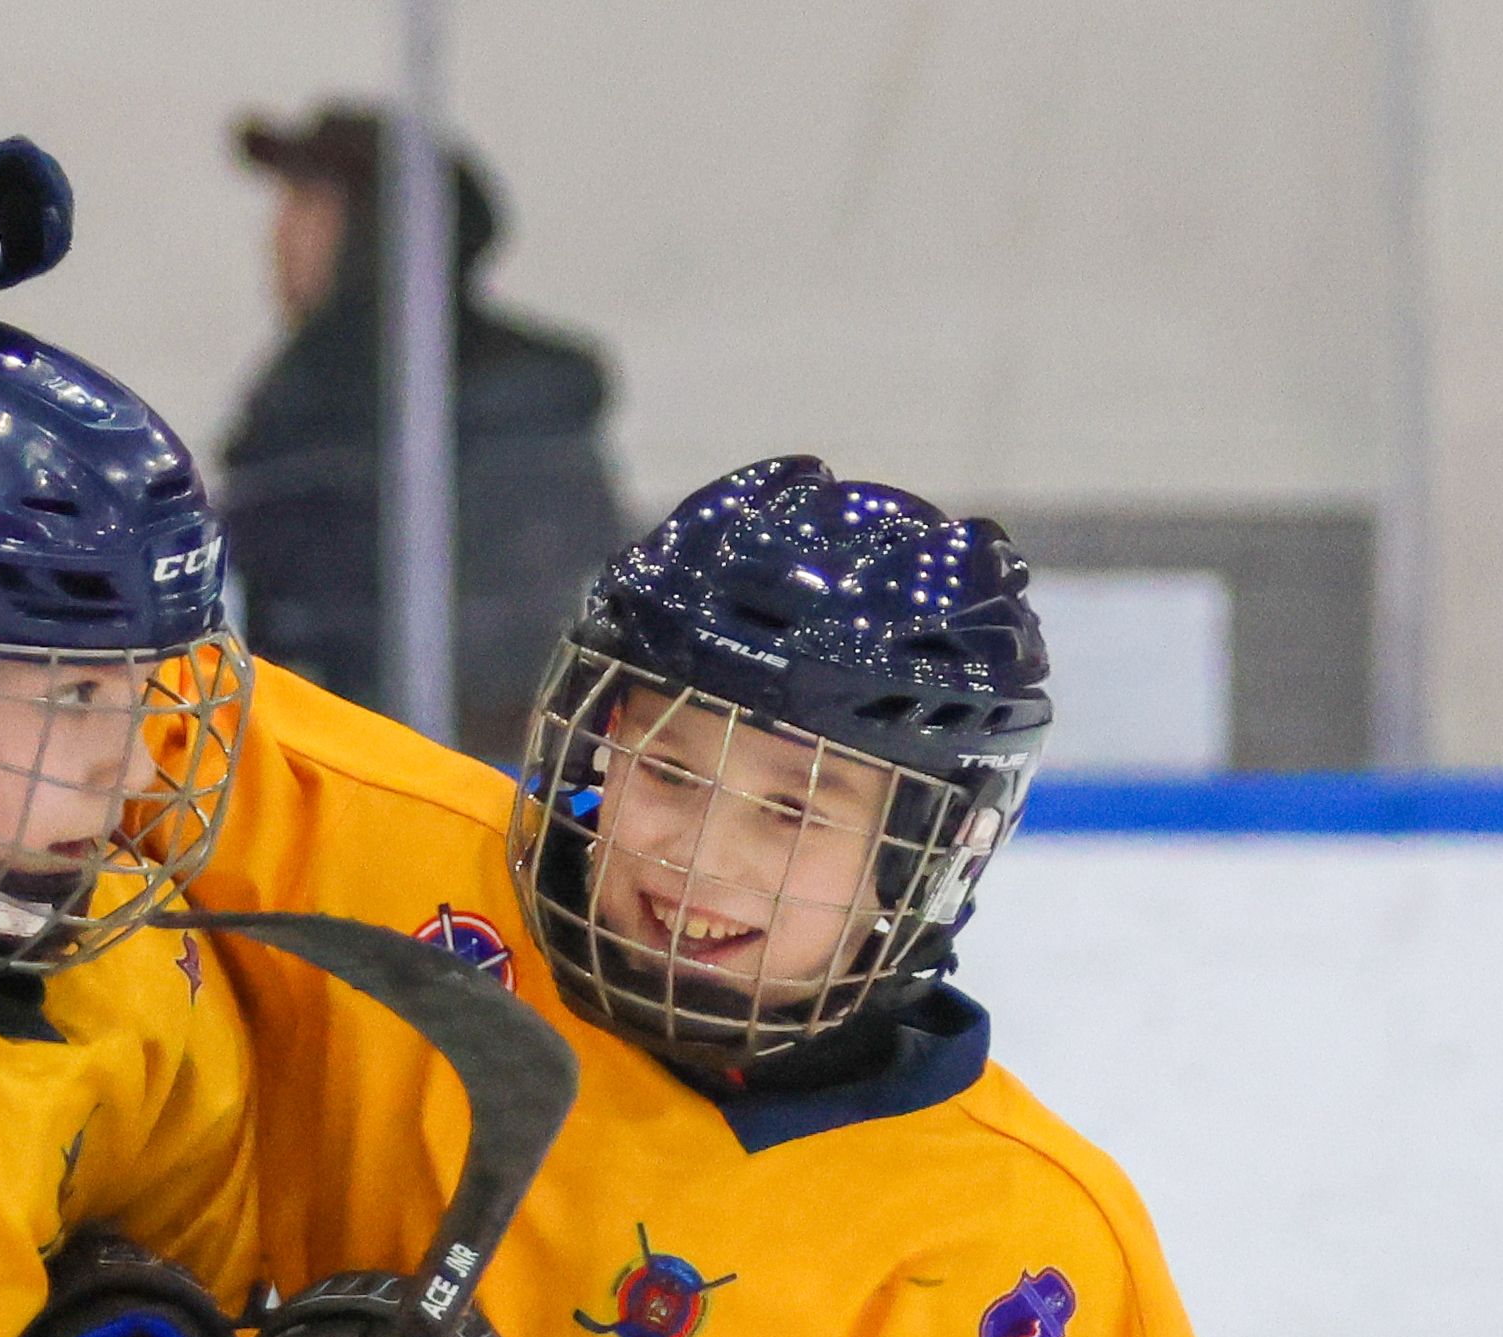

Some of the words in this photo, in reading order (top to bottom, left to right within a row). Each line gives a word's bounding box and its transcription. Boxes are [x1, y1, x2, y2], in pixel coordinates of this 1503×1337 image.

[695, 627, 790, 669] TRUE
[958, 752, 1030, 769] TRUE
[420, 1275, 459, 1321] ACE
[444, 1242, 480, 1279] JNR
